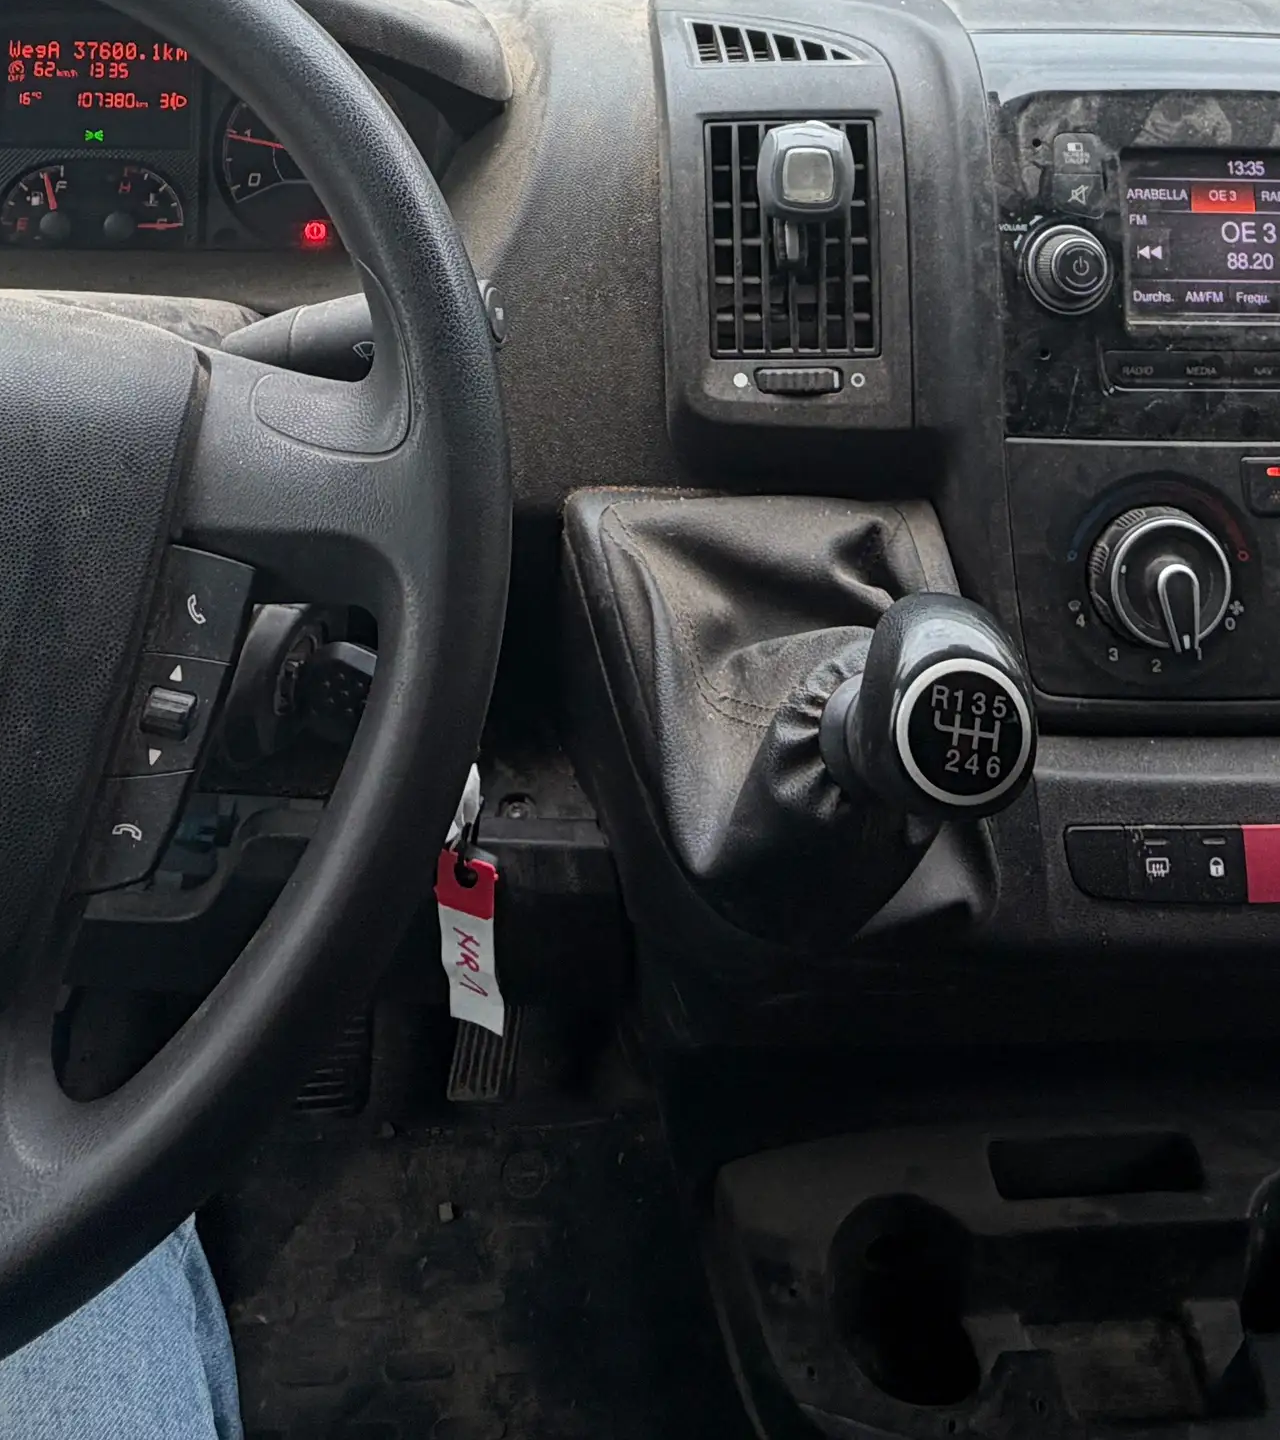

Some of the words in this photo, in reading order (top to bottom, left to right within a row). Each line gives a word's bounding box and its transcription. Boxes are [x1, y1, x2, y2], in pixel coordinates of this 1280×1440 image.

[8, 40, 61, 59] WegA
[1227, 160, 1266, 176] 13:35
[1126, 188, 1189, 201] ARABELLA
[1208, 189, 1227, 202] OE
[1229, 189, 1237, 202] 3
[1129, 214, 1148, 226] FM
[1221, 221, 1258, 243] OE
[1262, 222, 1277, 244] 3
[1227, 252, 1274, 270] 88.20
[1132, 290, 1175, 303] Durchs.
[1235, 291, 1270, 306] Frequ.
[1075, 613, 1085, 628] 4
[1108, 647, 1119, 662] 3
[1151, 658, 1162, 673] 2
